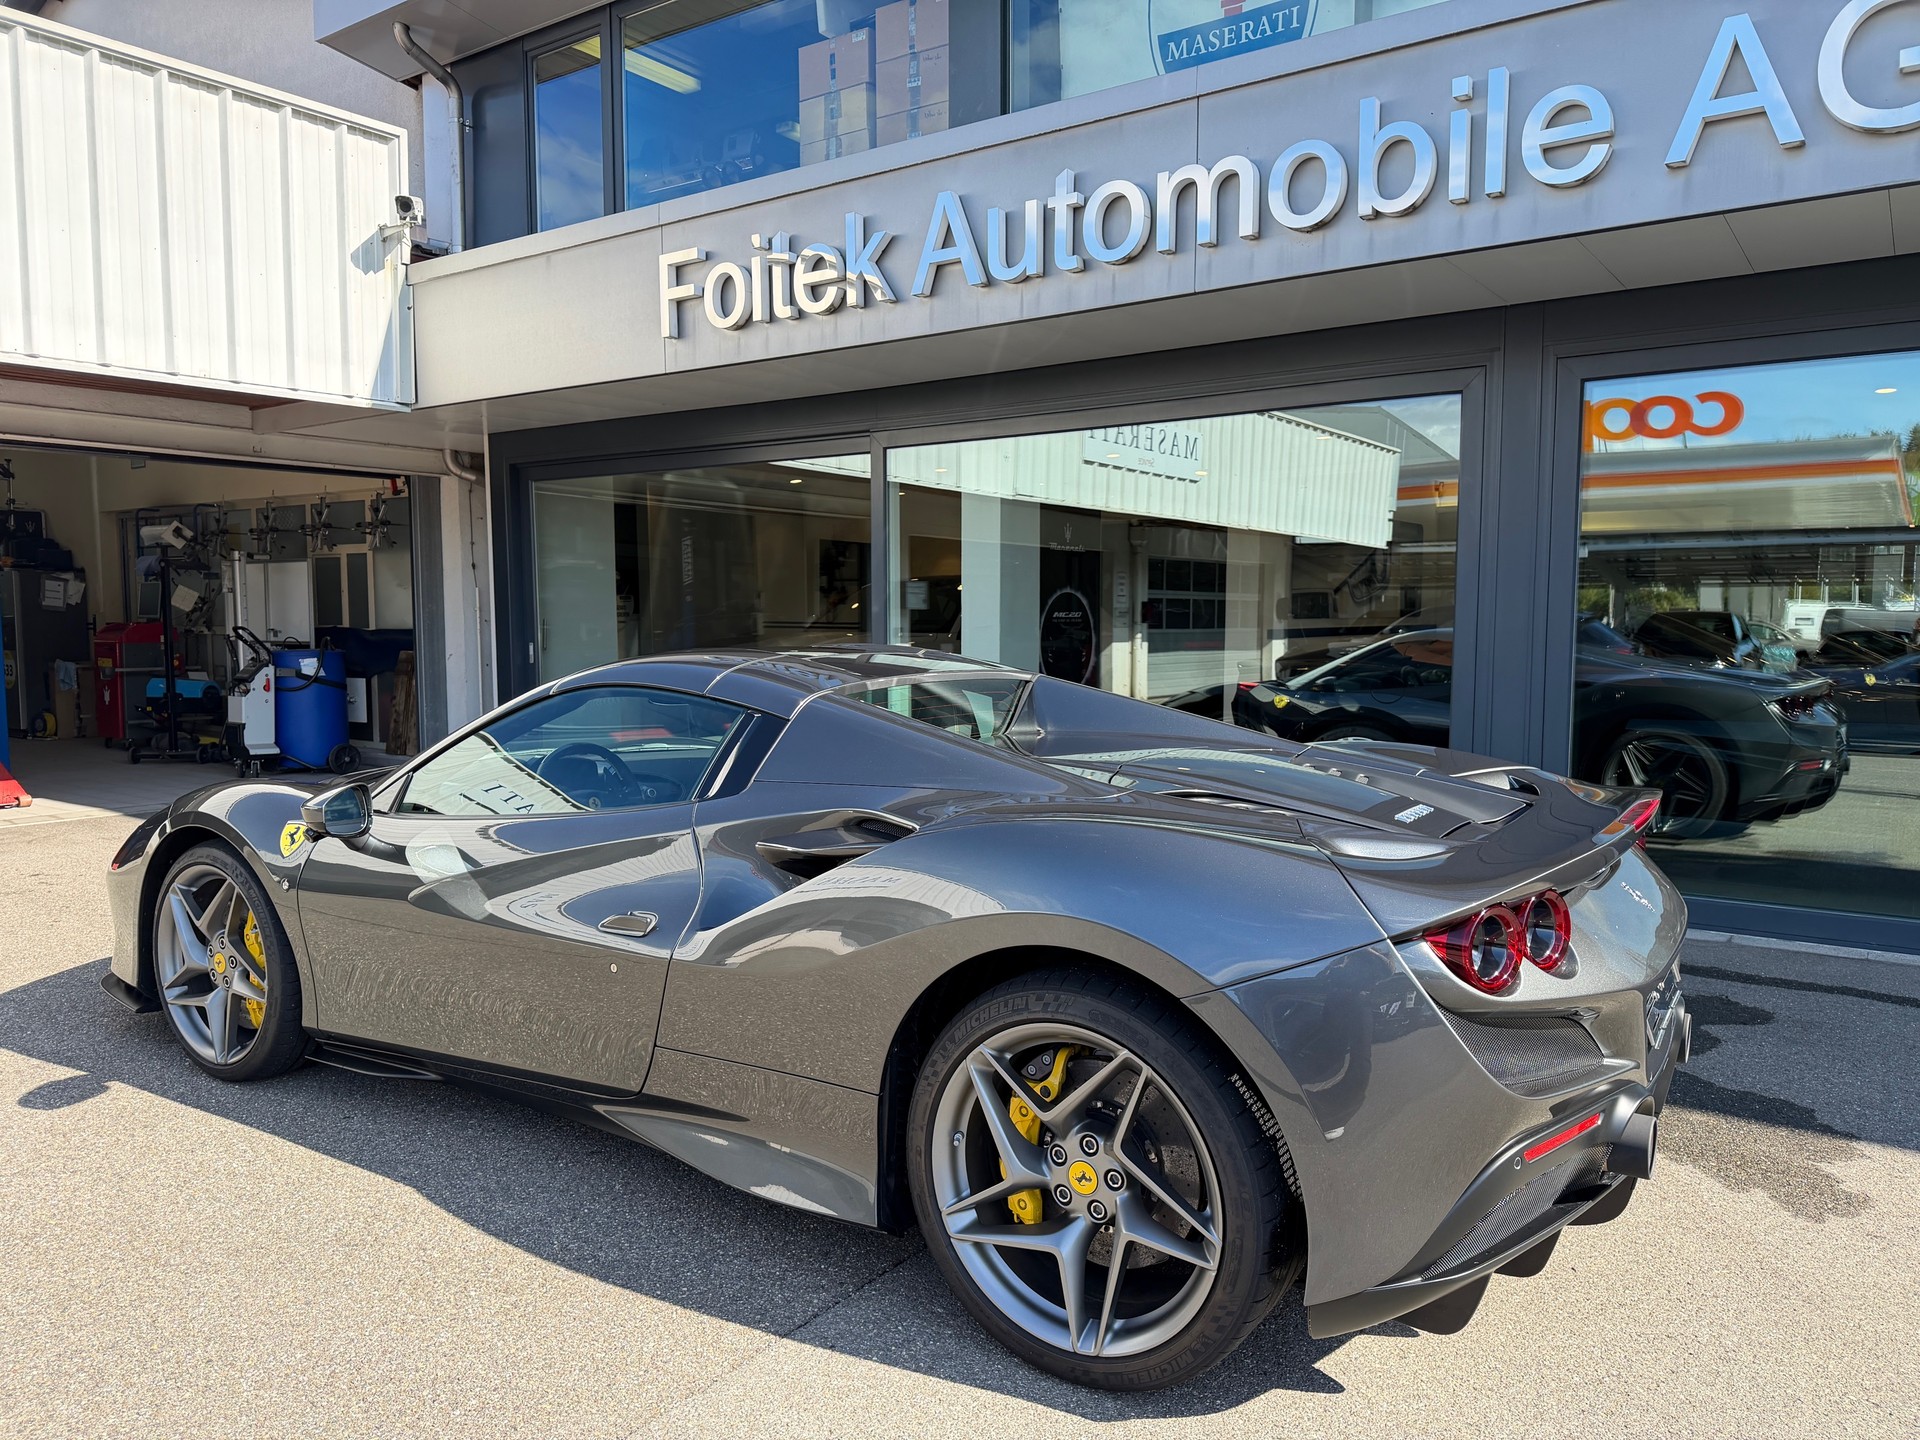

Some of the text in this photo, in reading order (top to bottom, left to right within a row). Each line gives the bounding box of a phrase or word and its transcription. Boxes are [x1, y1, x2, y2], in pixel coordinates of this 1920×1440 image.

[1166, 6, 1301, 62] MASERATI
[659, 0, 1920, 340] Foitek Automobile AG
[953, 996, 1027, 1042] MICHELIN
